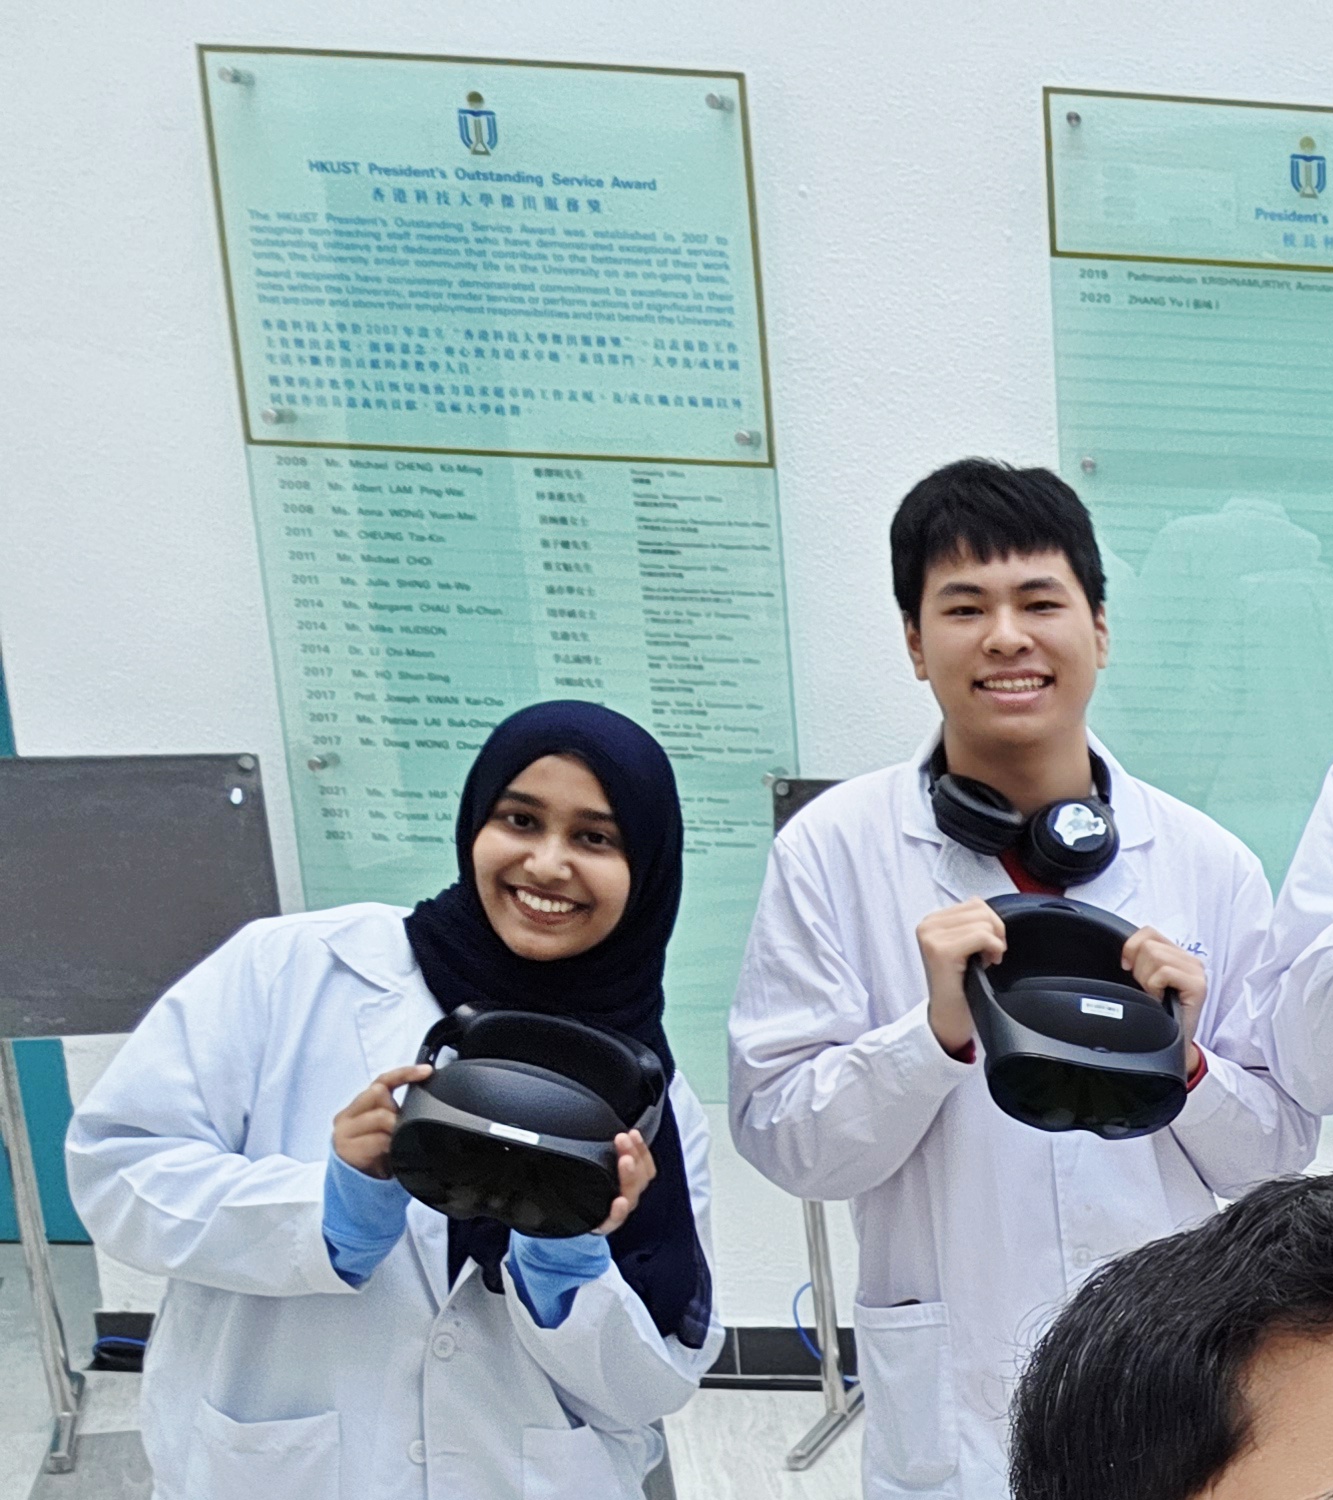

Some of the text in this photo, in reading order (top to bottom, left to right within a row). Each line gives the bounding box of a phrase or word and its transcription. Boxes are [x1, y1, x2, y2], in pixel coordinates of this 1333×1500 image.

[306, 161, 656, 190] HKUST President's Outstanding Service Award
[1255, 207, 1328, 224] President's
